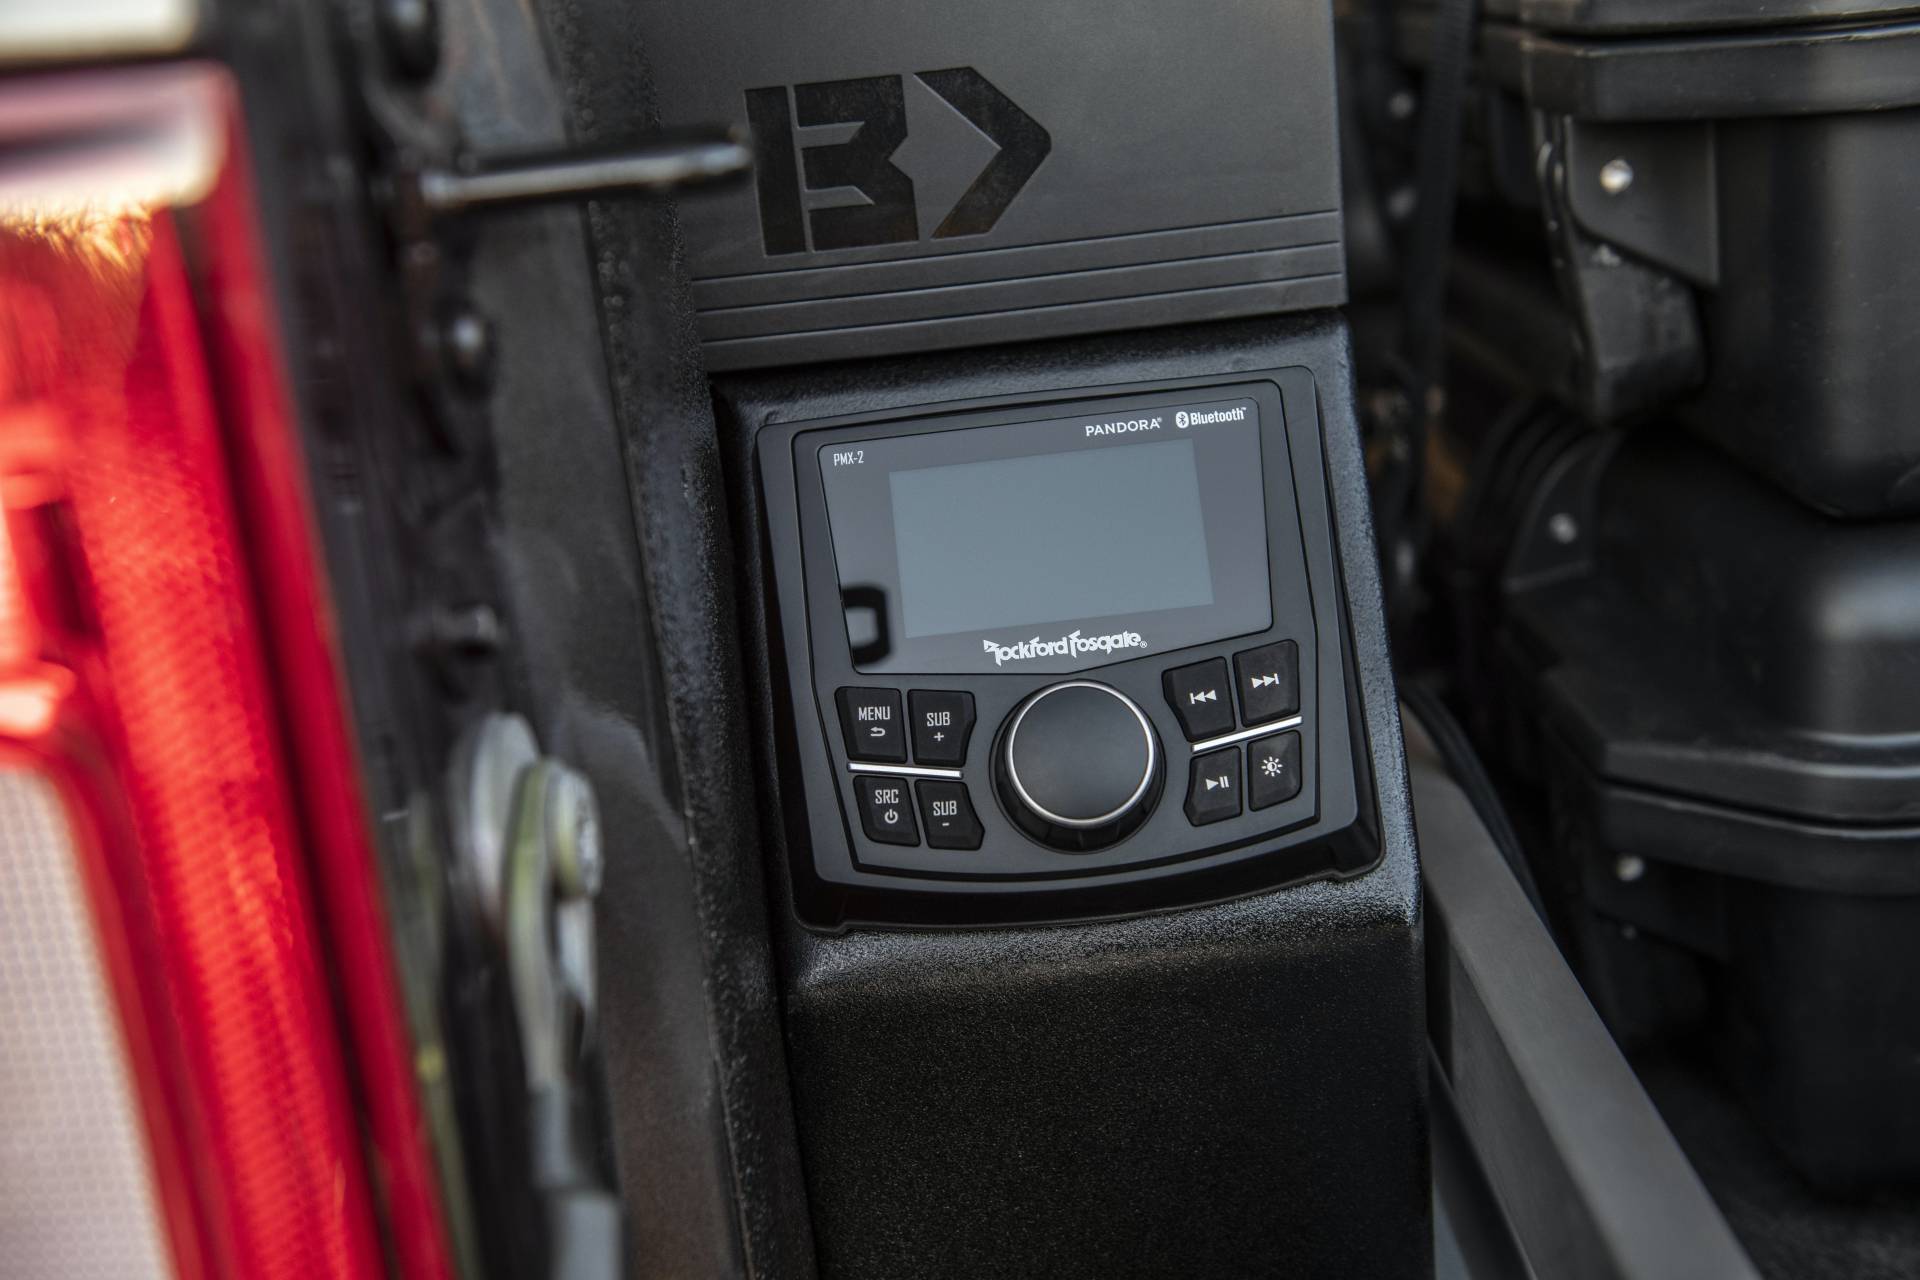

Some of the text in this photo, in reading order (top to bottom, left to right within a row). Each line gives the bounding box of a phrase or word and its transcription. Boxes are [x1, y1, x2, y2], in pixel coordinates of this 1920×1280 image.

[833, 450, 864, 466] PMX-2
[983, 636, 1069, 667] Rockford
[858, 706, 891, 721] MENU
[926, 711, 951, 727] SUB
[874, 789, 899, 805] SRC
[932, 800, 958, 817] SUB
